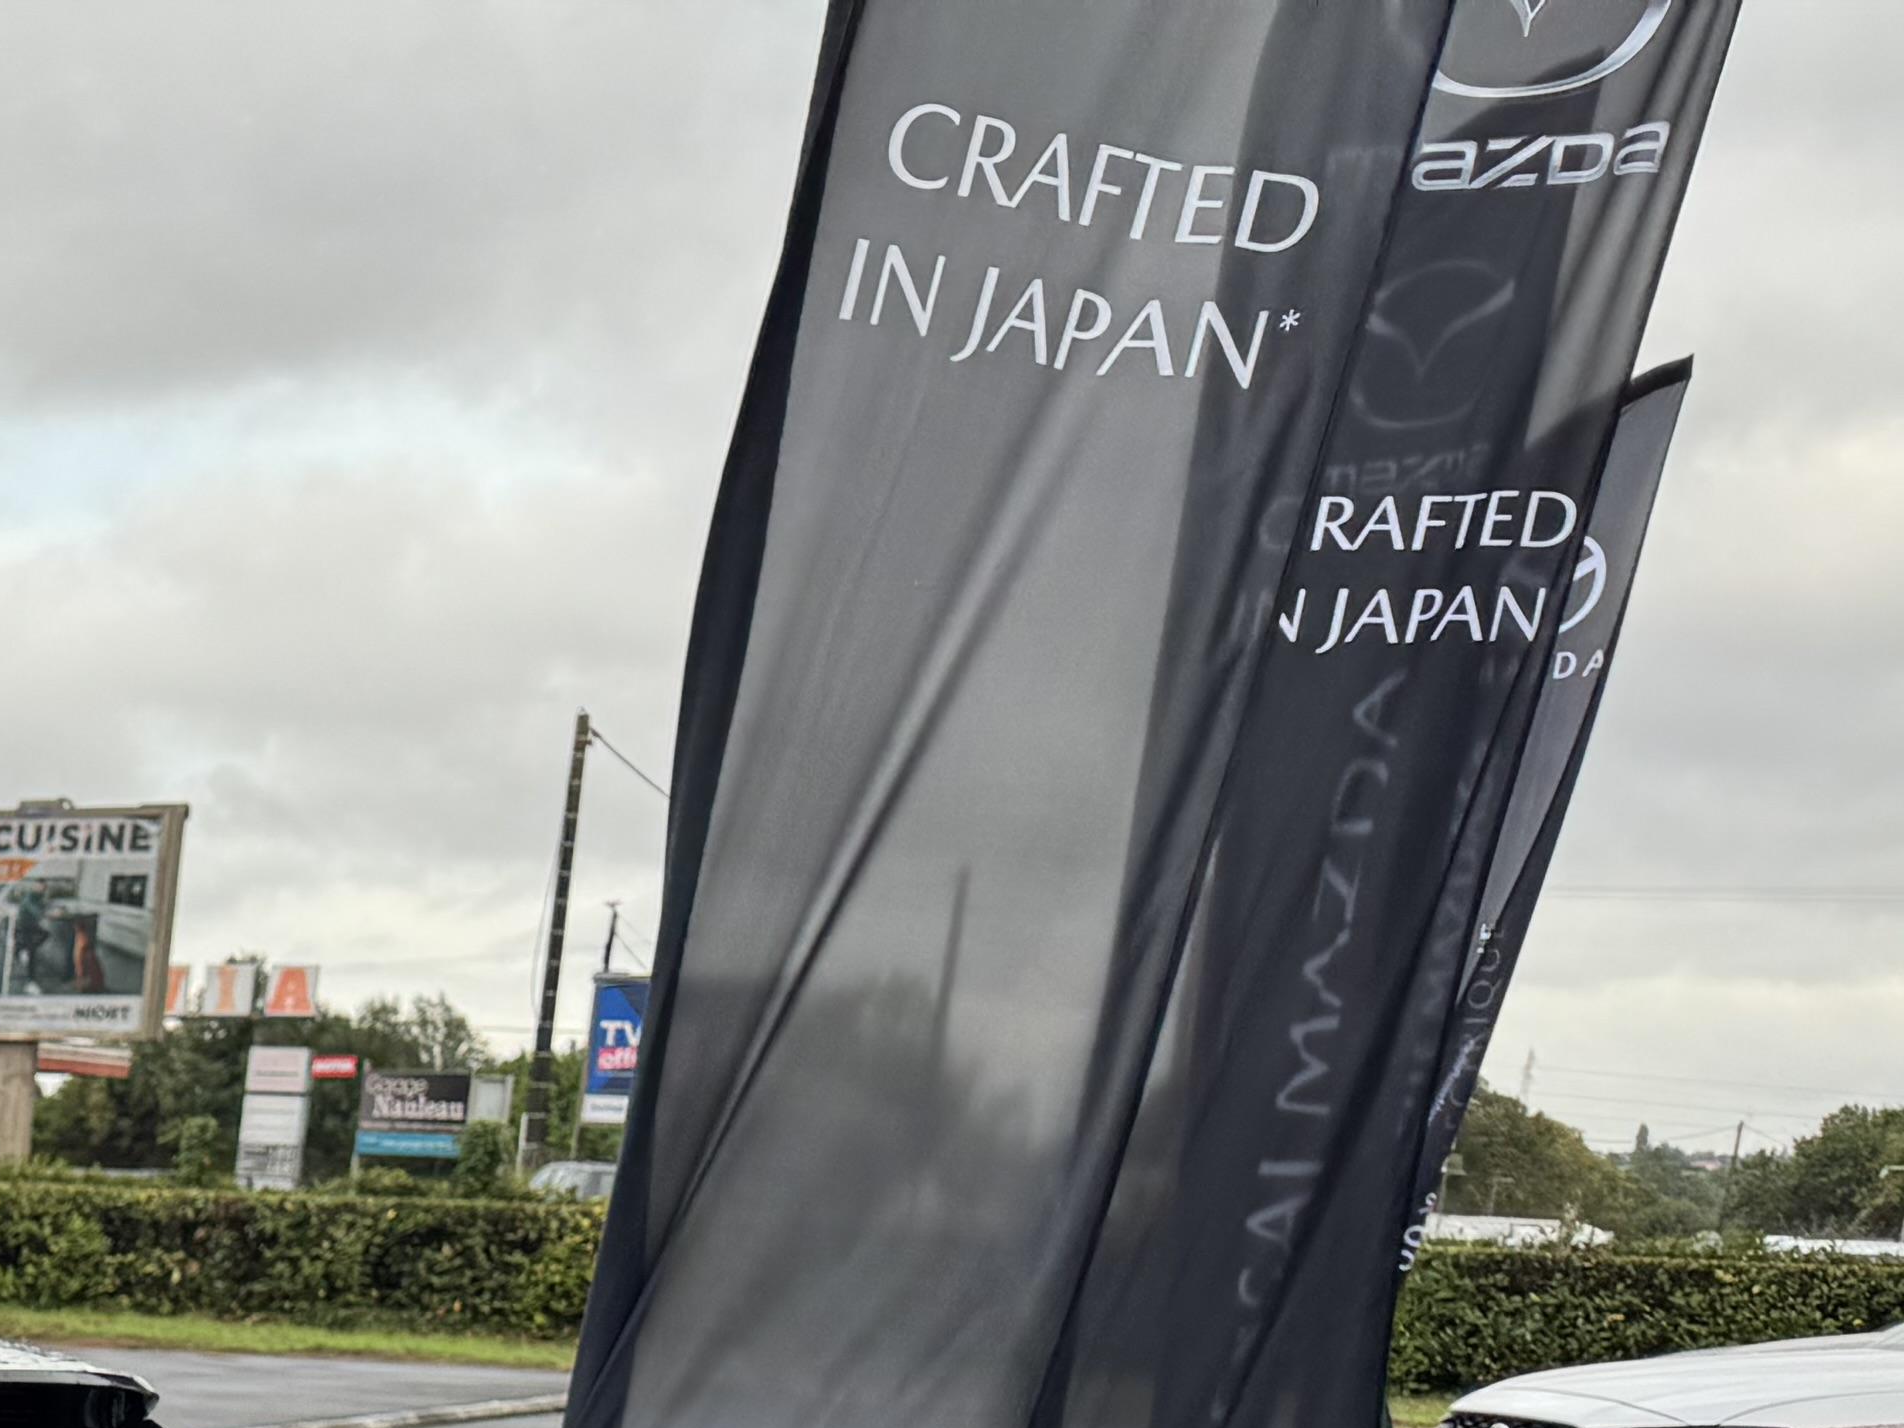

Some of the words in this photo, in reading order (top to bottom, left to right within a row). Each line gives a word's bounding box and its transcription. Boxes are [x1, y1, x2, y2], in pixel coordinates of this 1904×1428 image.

[887, 102, 1320, 253] CRAFTED
[839, 238, 946, 337] IN
[1309, 490, 1578, 551] RAFTED
[1279, 588, 1307, 643] N
[1315, 585, 1547, 654] JAPAN
